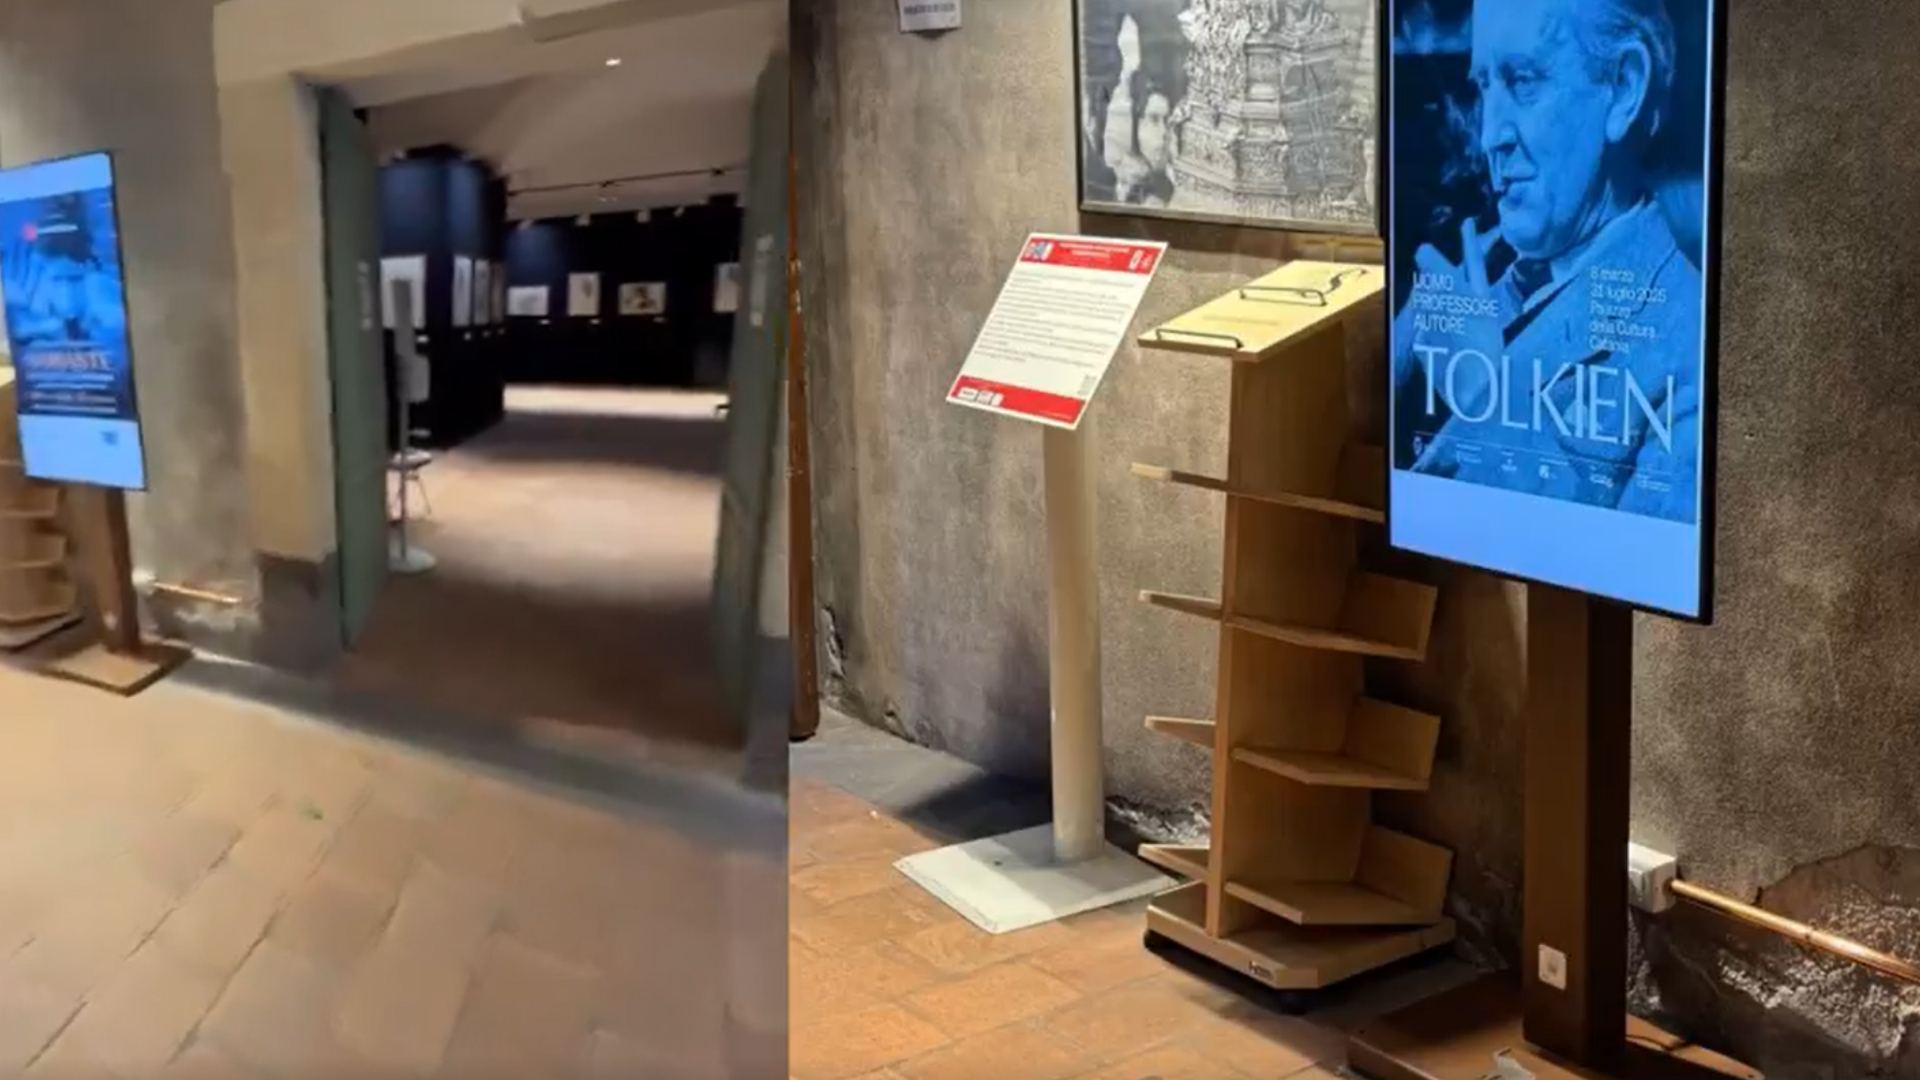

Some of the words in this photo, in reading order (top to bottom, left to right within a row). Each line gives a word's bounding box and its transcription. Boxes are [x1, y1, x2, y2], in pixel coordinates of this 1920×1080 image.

[1412, 271, 1454, 291] UOMO
[1413, 292, 1498, 317] PROFESSORE
[1412, 314, 1465, 334] AUTORE
[1412, 344, 1675, 455] TOLKIEN
